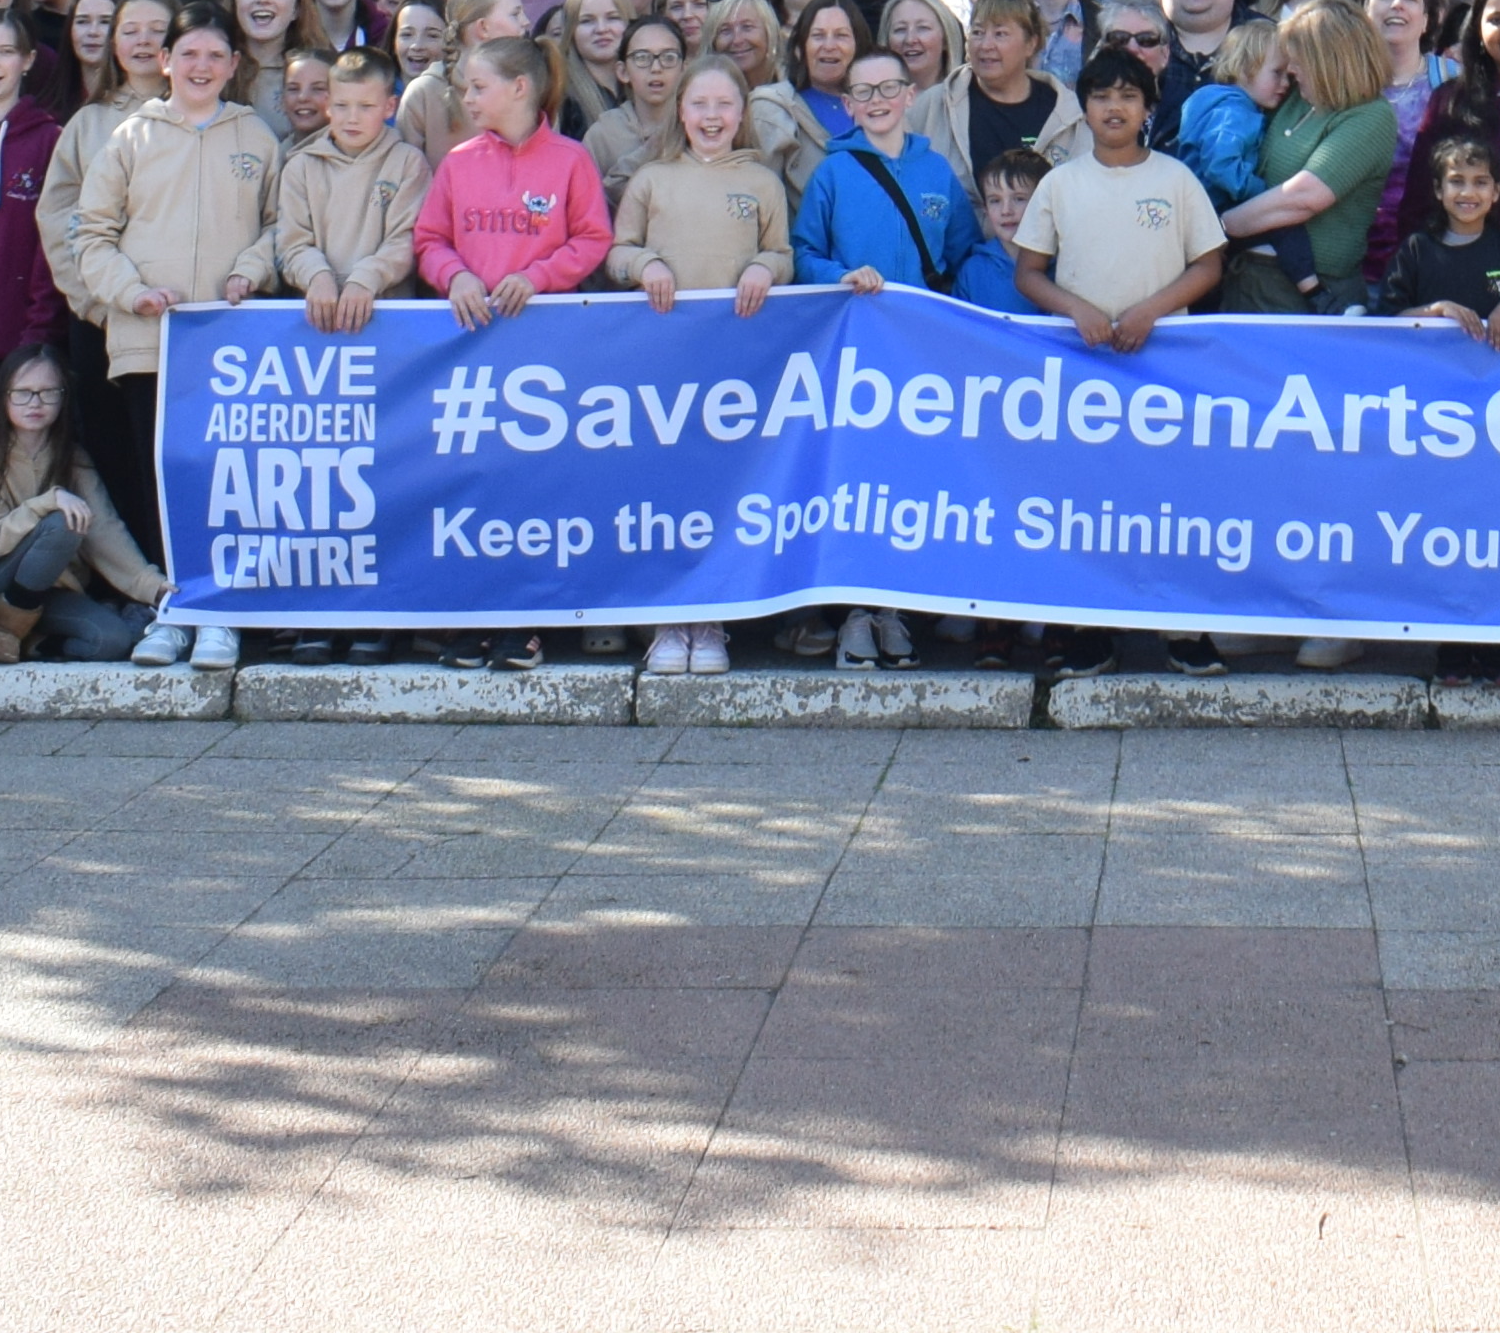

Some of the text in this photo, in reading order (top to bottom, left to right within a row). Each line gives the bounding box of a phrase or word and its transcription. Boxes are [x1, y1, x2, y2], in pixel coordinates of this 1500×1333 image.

[210, 345, 377, 397] SAVE
[205, 402, 377, 443] ABERDEEN
[208, 446, 376, 531] ARTS
[433, 507, 594, 568] Keep
[614, 501, 714, 553] the
[735, 482, 995, 557] Spotlight
[1014, 496, 1253, 572] Shining
[1275, 520, 1354, 563] on
[211, 533, 378, 589] CENTRE
